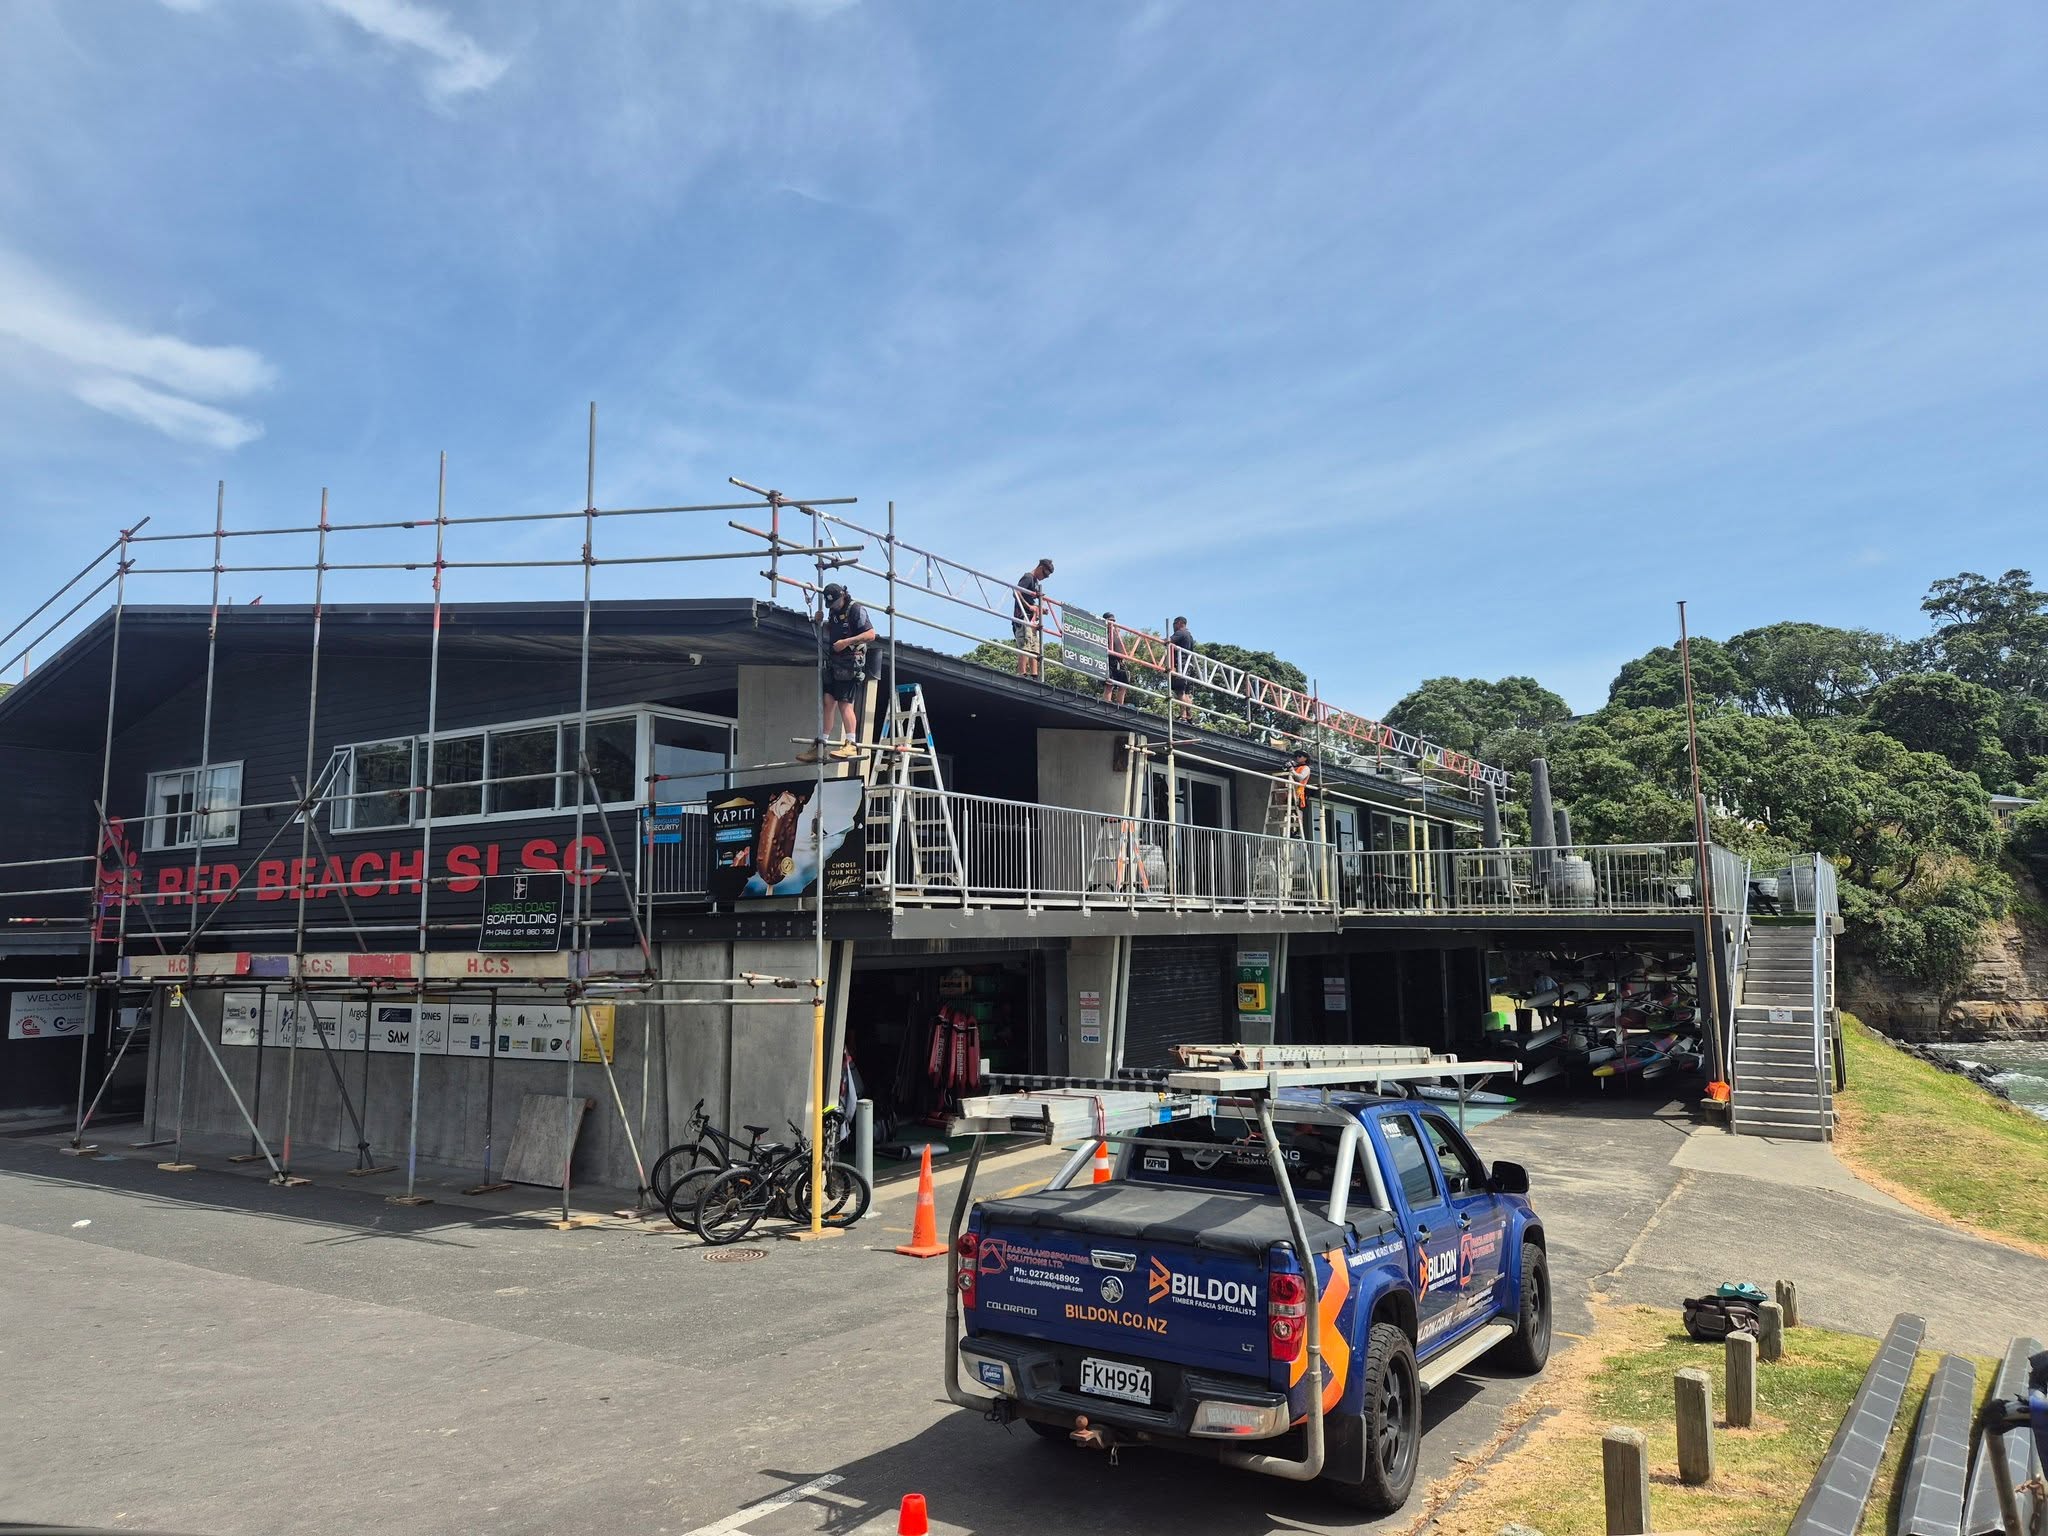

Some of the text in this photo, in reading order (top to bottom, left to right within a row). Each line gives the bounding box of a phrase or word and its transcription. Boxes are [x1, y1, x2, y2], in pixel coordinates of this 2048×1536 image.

[1064, 623, 1107, 646] SCAFFOLDING
[1064, 650, 1077, 660] 021
[714, 808, 755, 824] KĀPITI
[653, 823, 680, 831] SECURITY
[156, 863, 241, 906] RED
[256, 849, 423, 901] BEACH
[524, 902, 557, 913] COAST
[486, 914, 557, 924] SCAFFOLDING
[512, 928, 524, 936] 021
[168, 959, 199, 973] H.C..
[467, 958, 514, 974] H.C.S.
[27, 992, 82, 1002] WELCOME
[388, 1030, 410, 1044] SAM
[1236, 1156, 1300, 1168] COMMUTY
[1006, 1245, 1035, 1257] FASCIA
[1052, 1252, 1092, 1266] SPOUTING
[1006, 1254, 1065, 1270] SOLUTIONS LTD.
[1428, 1248, 1457, 1282] BILDON
[1014, 1266, 1080, 1284] Ph: 0272648902
[1172, 1272, 1256, 1308] BILDON
[986, 1300, 1038, 1316] COLORADO
[1172, 1296, 1256, 1316] TIMBER FASCIA SPECIALISTS
[1065, 1304, 1168, 1334] BILDON.CO.NZ
[1242, 1344, 1254, 1352] LT
[1082, 1363, 1150, 1397] FKH994
